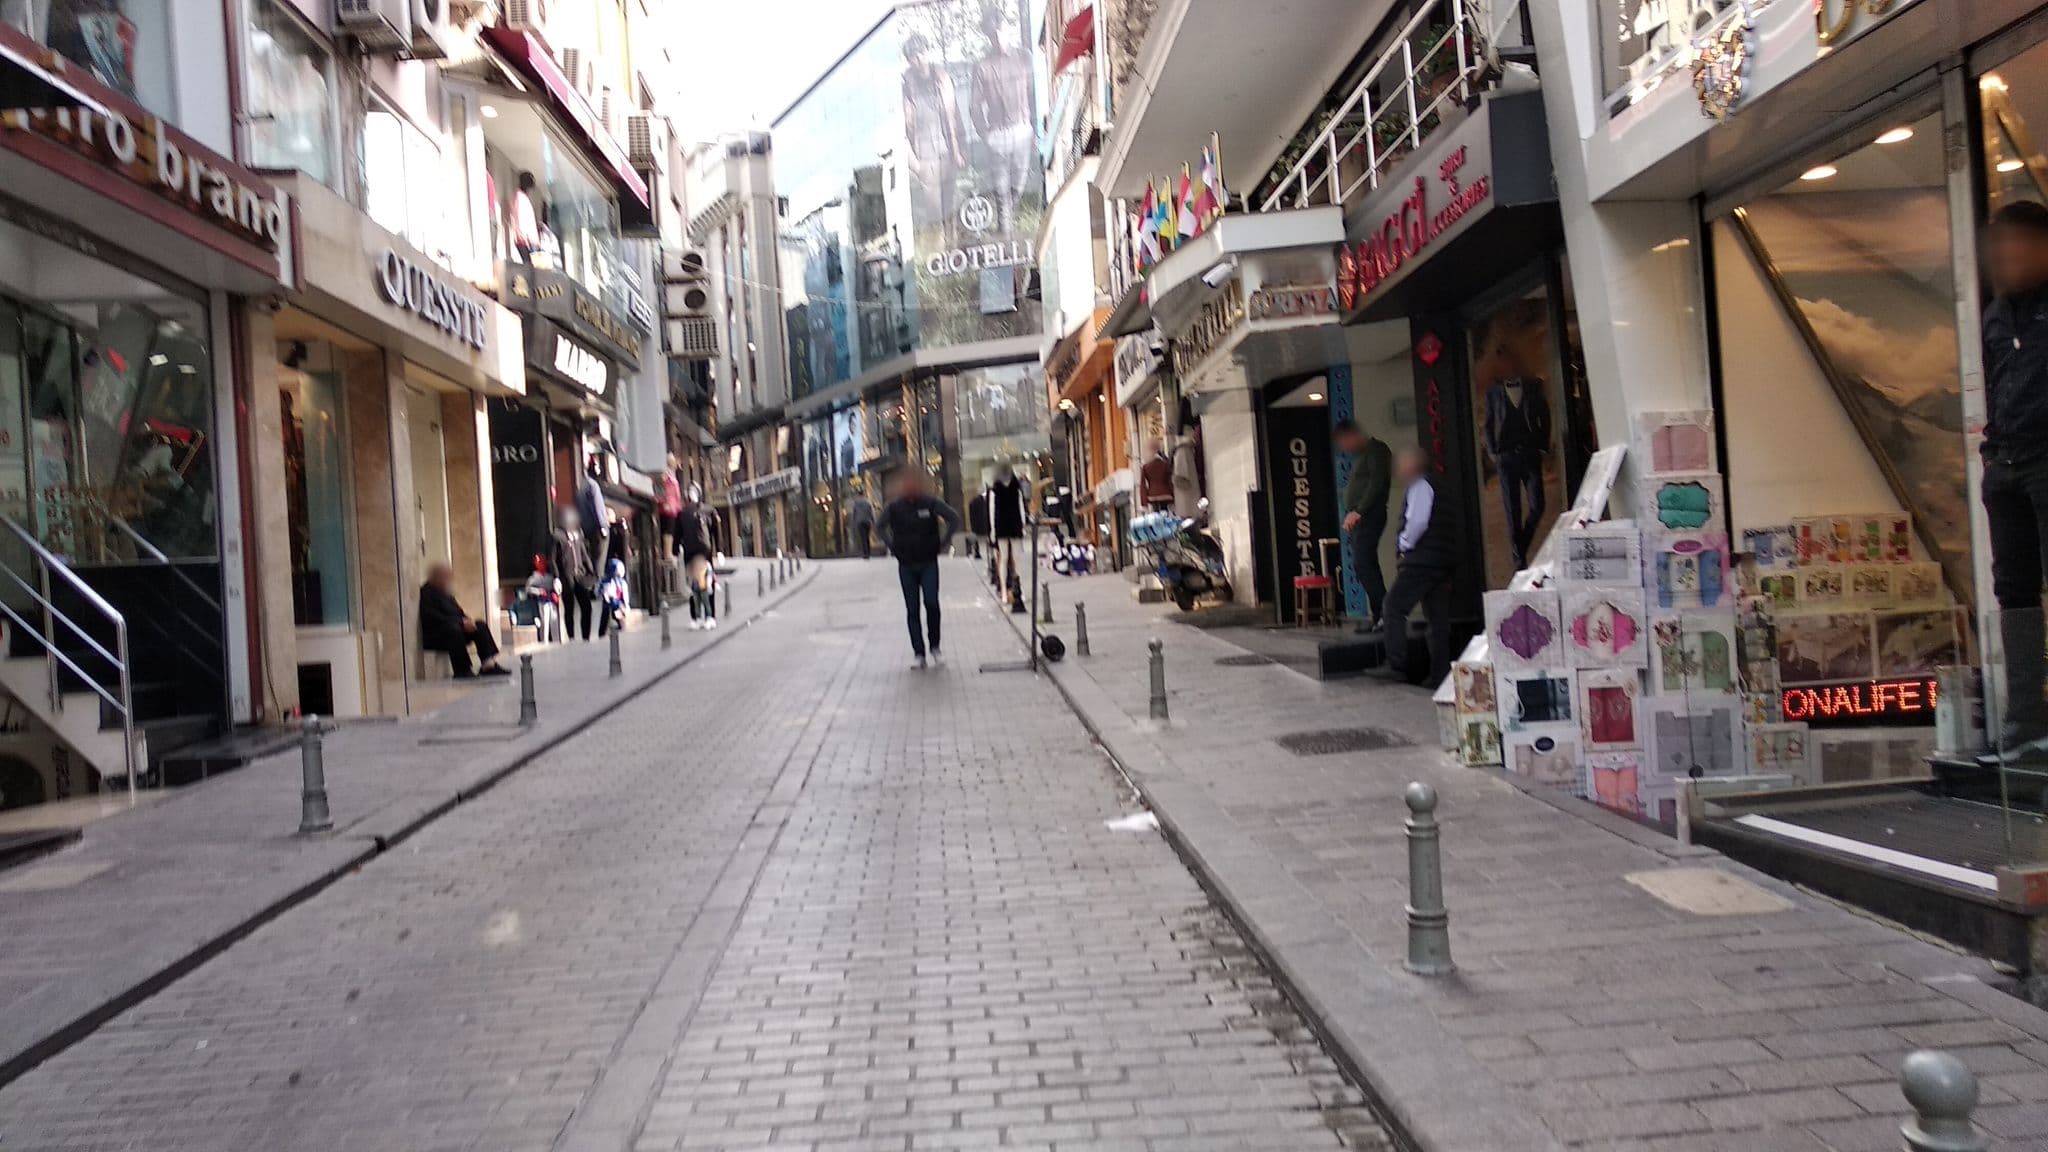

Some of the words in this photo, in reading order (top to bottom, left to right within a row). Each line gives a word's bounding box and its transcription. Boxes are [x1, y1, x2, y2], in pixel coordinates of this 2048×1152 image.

[154, 117, 291, 252] brand
[377, 247, 487, 351] QUESSTE
[926, 238, 1036, 277] GIOTELLI
[1289, 437, 1317, 577] QUESSTE
